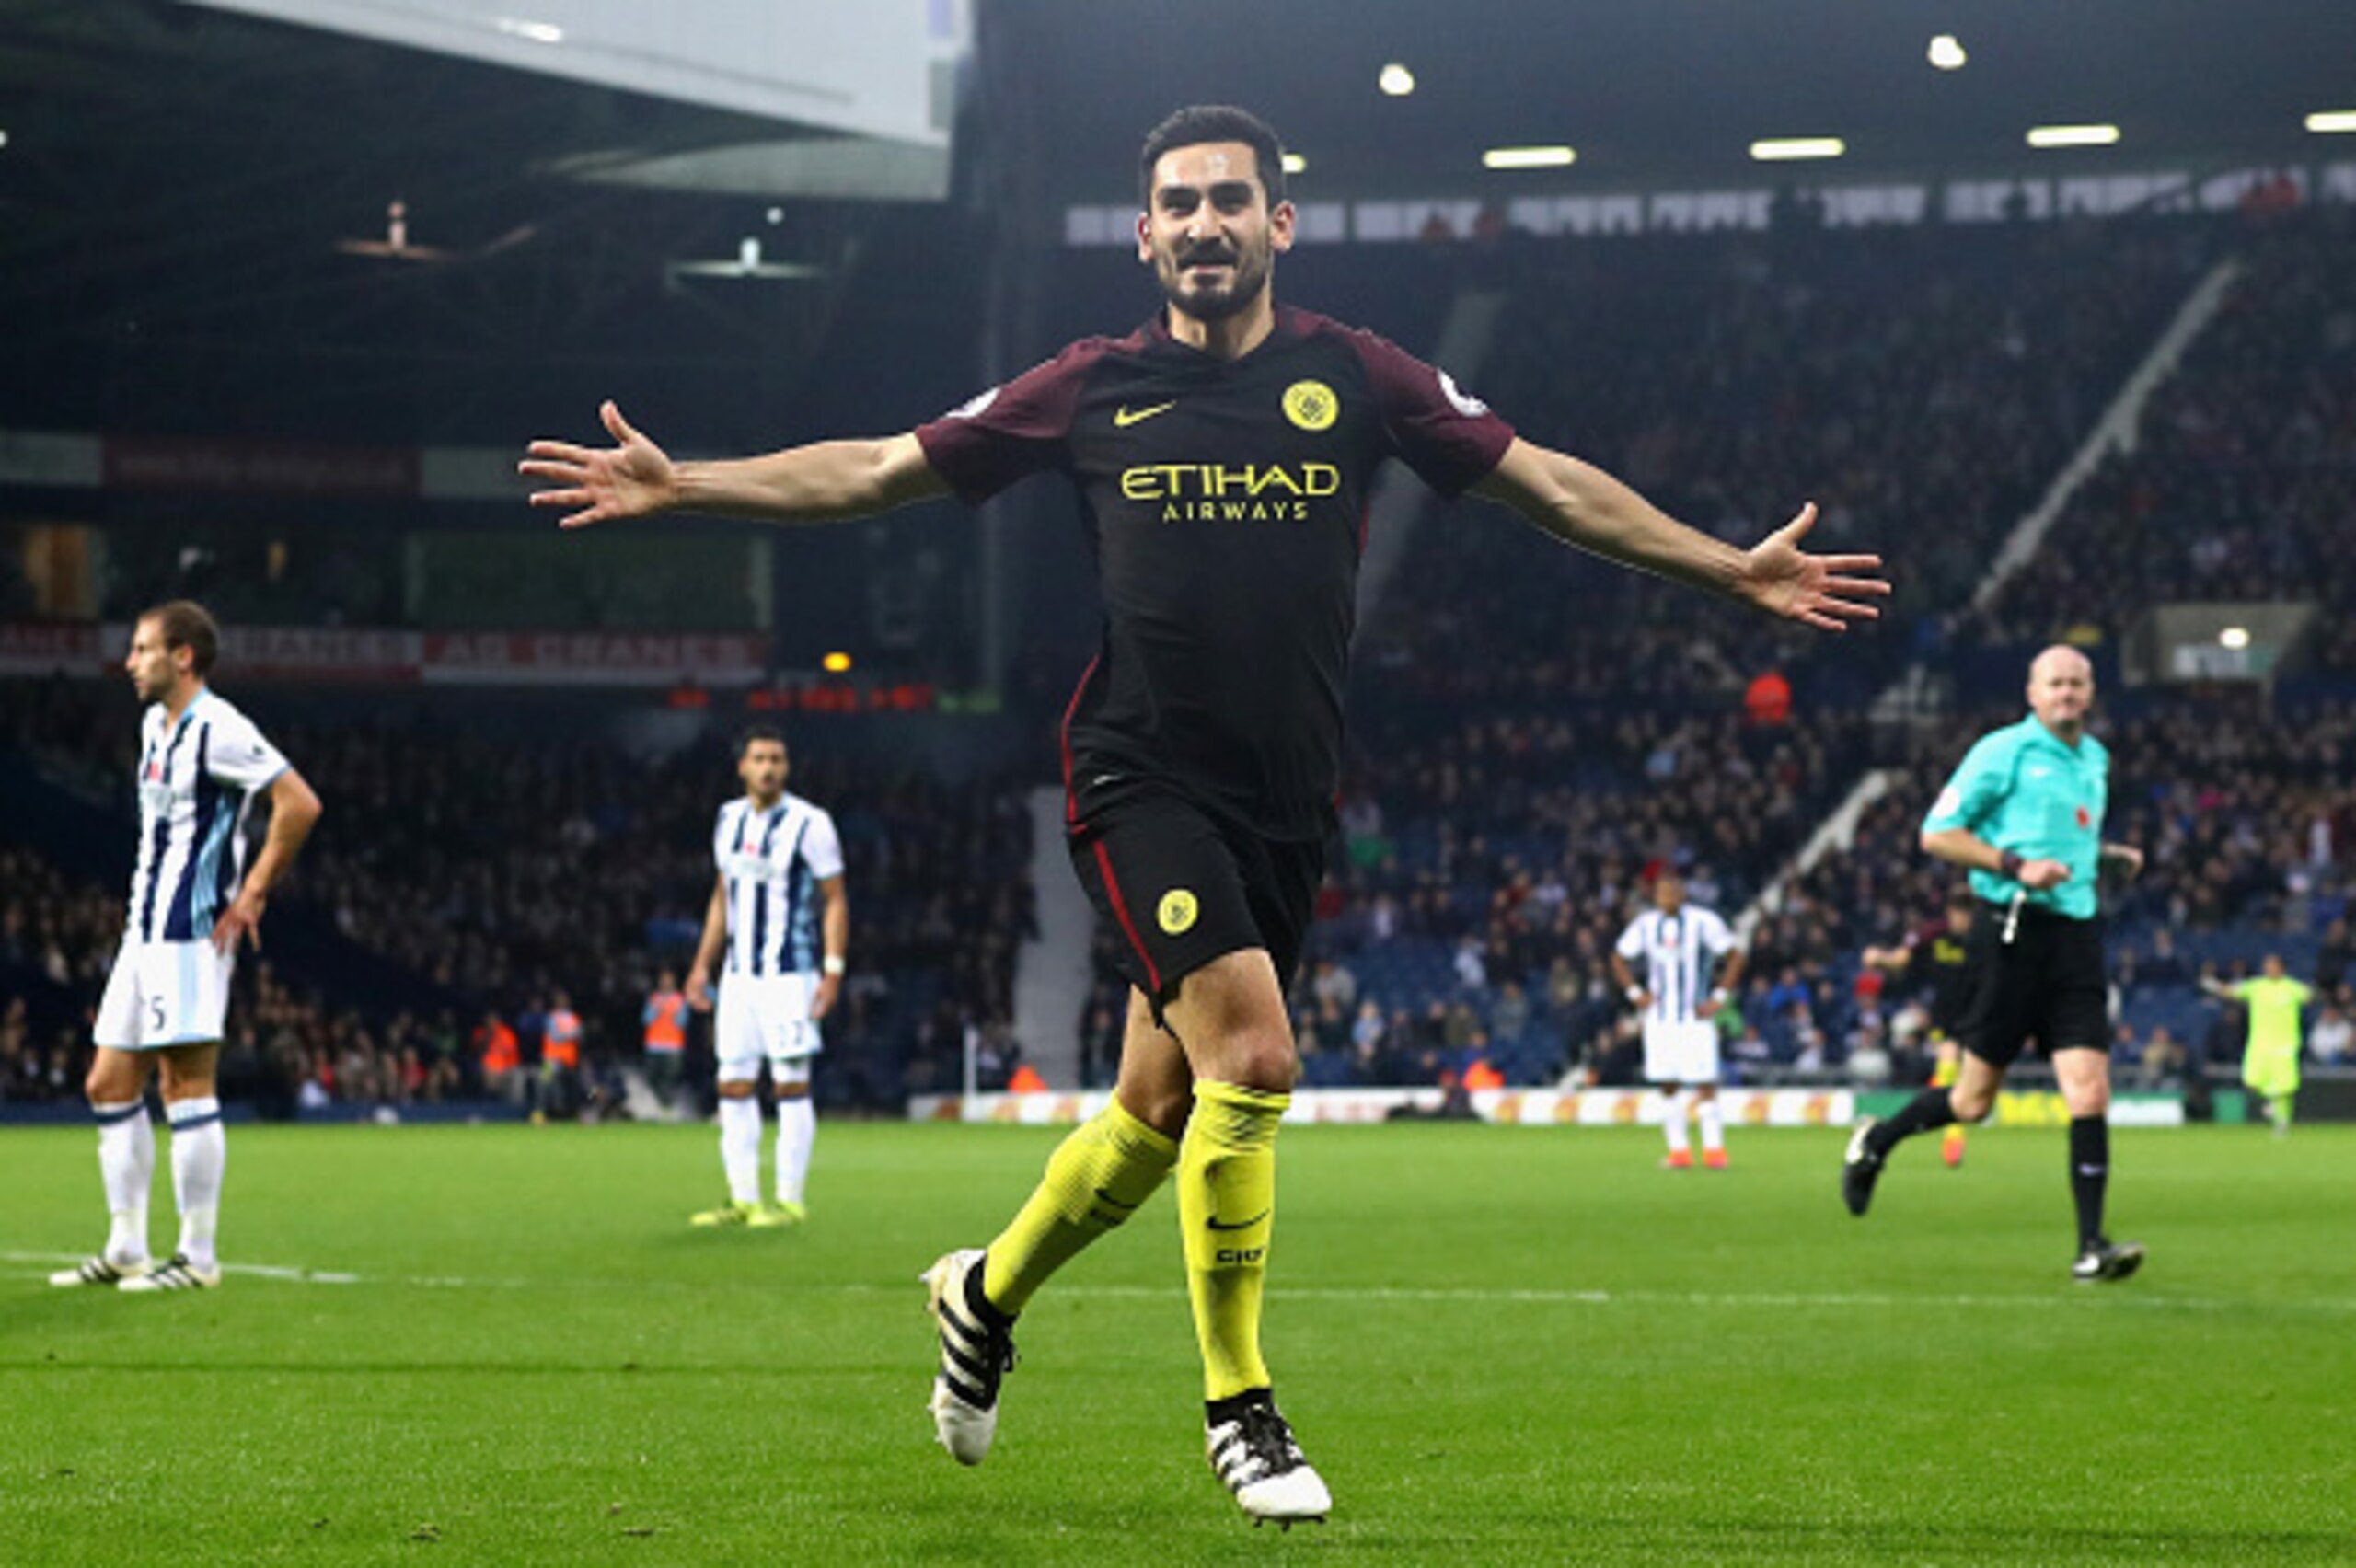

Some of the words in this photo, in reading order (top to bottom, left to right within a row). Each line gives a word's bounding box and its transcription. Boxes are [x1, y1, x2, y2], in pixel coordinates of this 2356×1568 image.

[1120, 463, 1340, 501] ETIHAD
[1162, 502, 1309, 523] AIRWAYS
[150, 995, 166, 1031] 5
